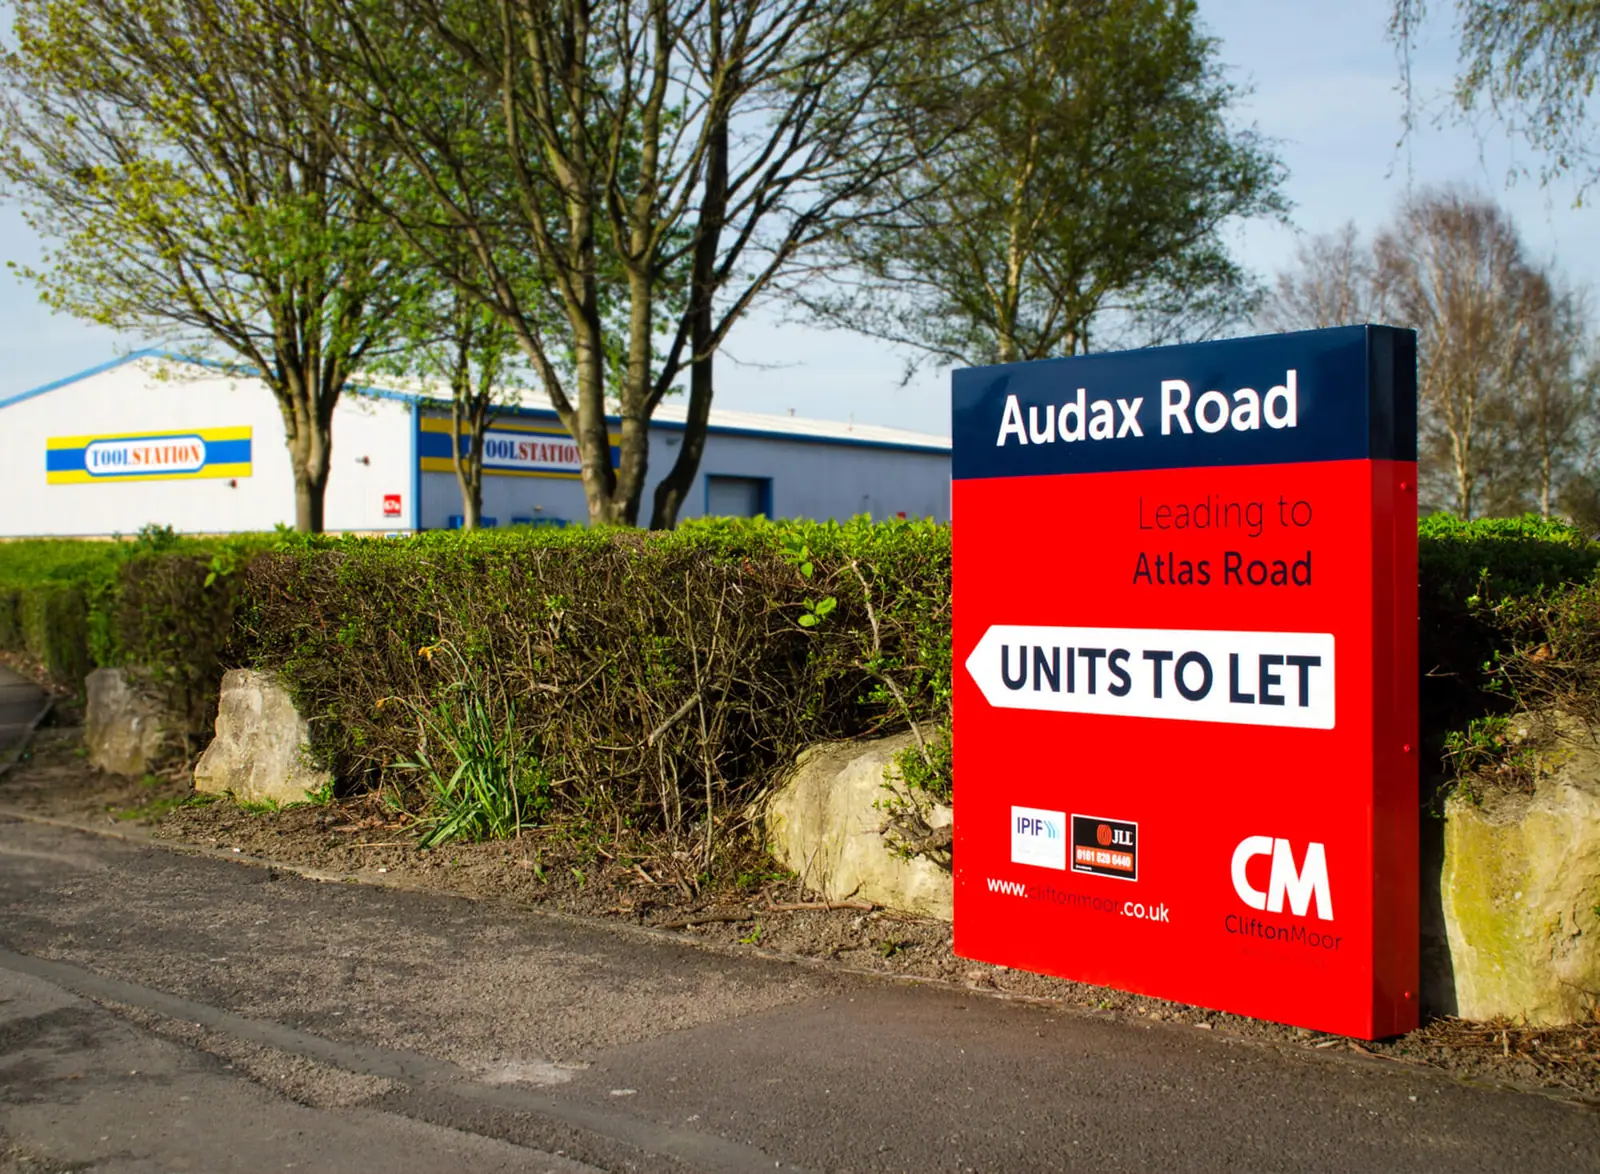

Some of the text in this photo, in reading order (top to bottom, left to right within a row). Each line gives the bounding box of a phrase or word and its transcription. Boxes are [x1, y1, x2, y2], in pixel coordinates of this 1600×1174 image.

[996, 369, 1298, 447] Audax Road
[92, 444, 201, 467] TOOLSTATION
[1138, 495, 1312, 537] Leading to
[1133, 551, 1312, 586] Atlas Road
[1001, 644, 1321, 707] UNITS TO LET
[1017, 816, 1043, 836] IPIF
[1111, 829, 1133, 846] JLL
[1231, 835, 1334, 921] CM
[987, 878, 1170, 923] www.cliftonmoor.co.uk
[1225, 914, 1342, 950] CliftonMoor
